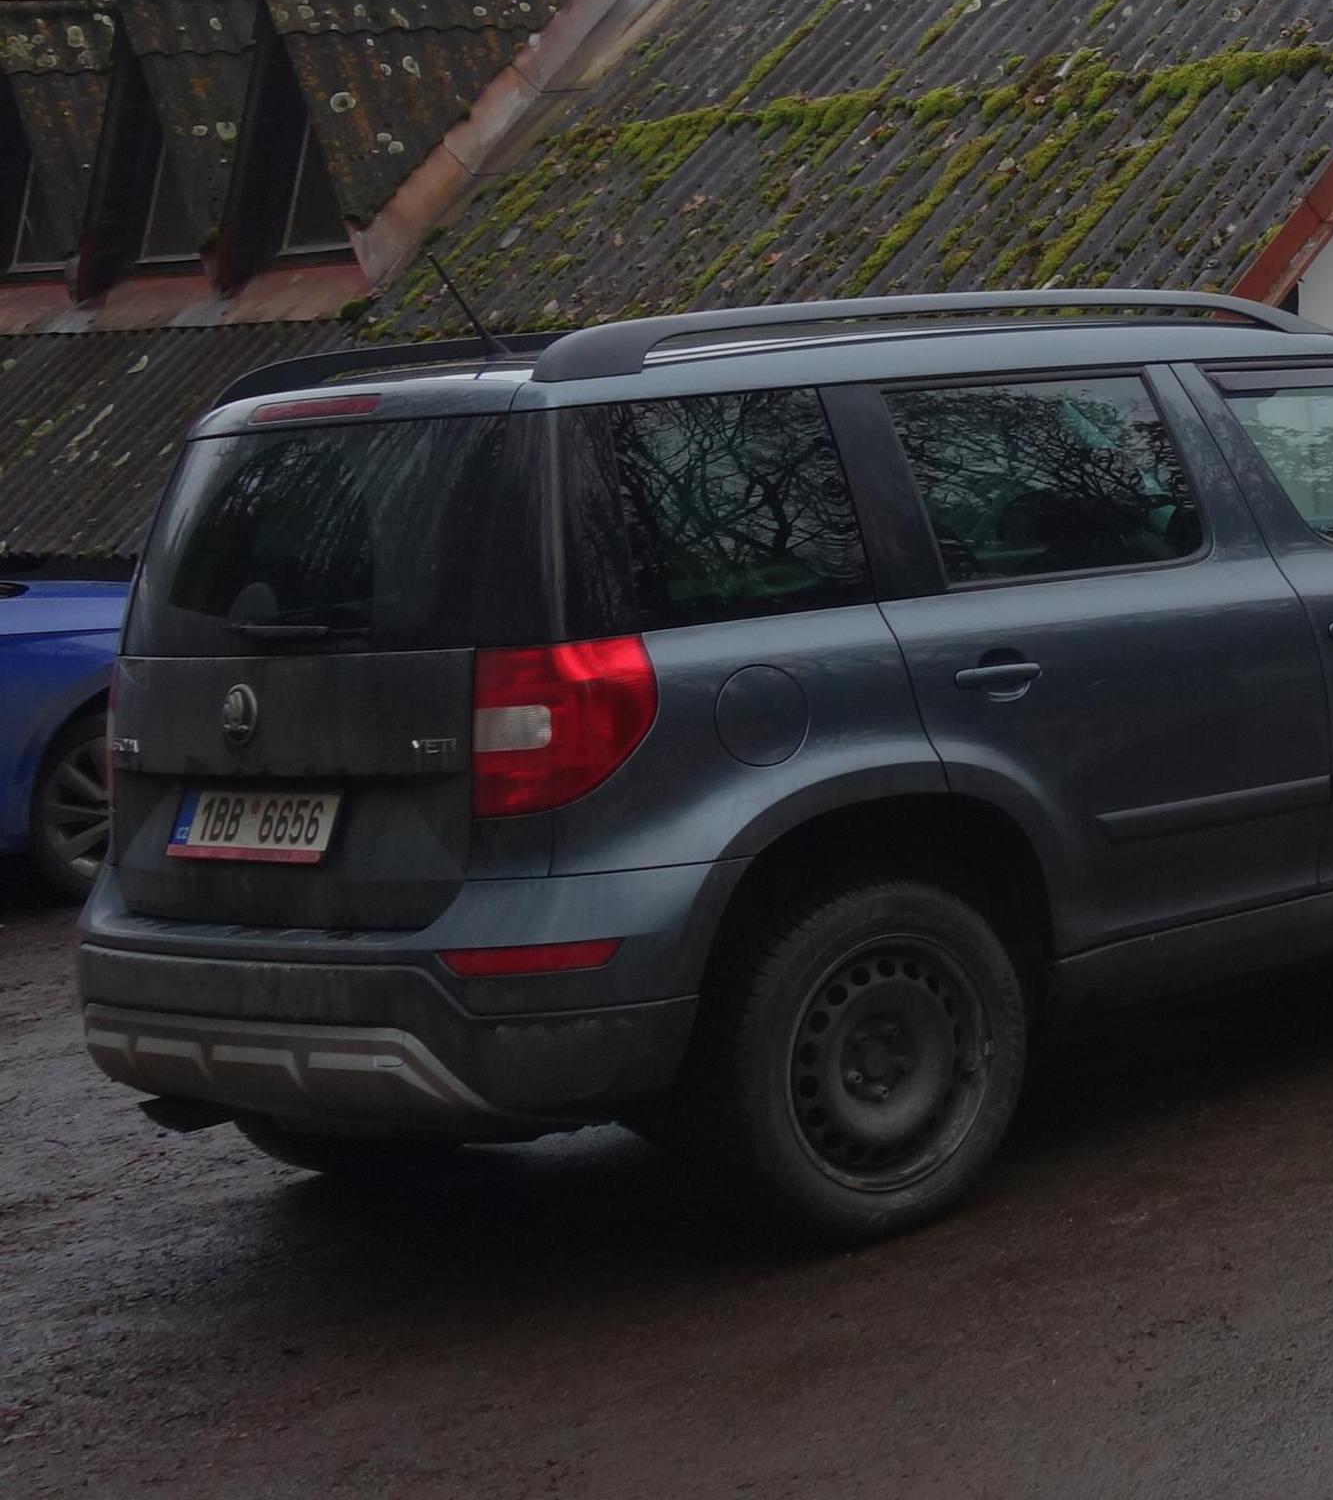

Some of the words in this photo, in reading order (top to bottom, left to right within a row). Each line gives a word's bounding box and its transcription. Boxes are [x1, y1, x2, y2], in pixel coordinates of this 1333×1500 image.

[411, 738, 457, 754] YETI
[200, 797, 246, 842] 1BB
[258, 799, 325, 846] 6656
